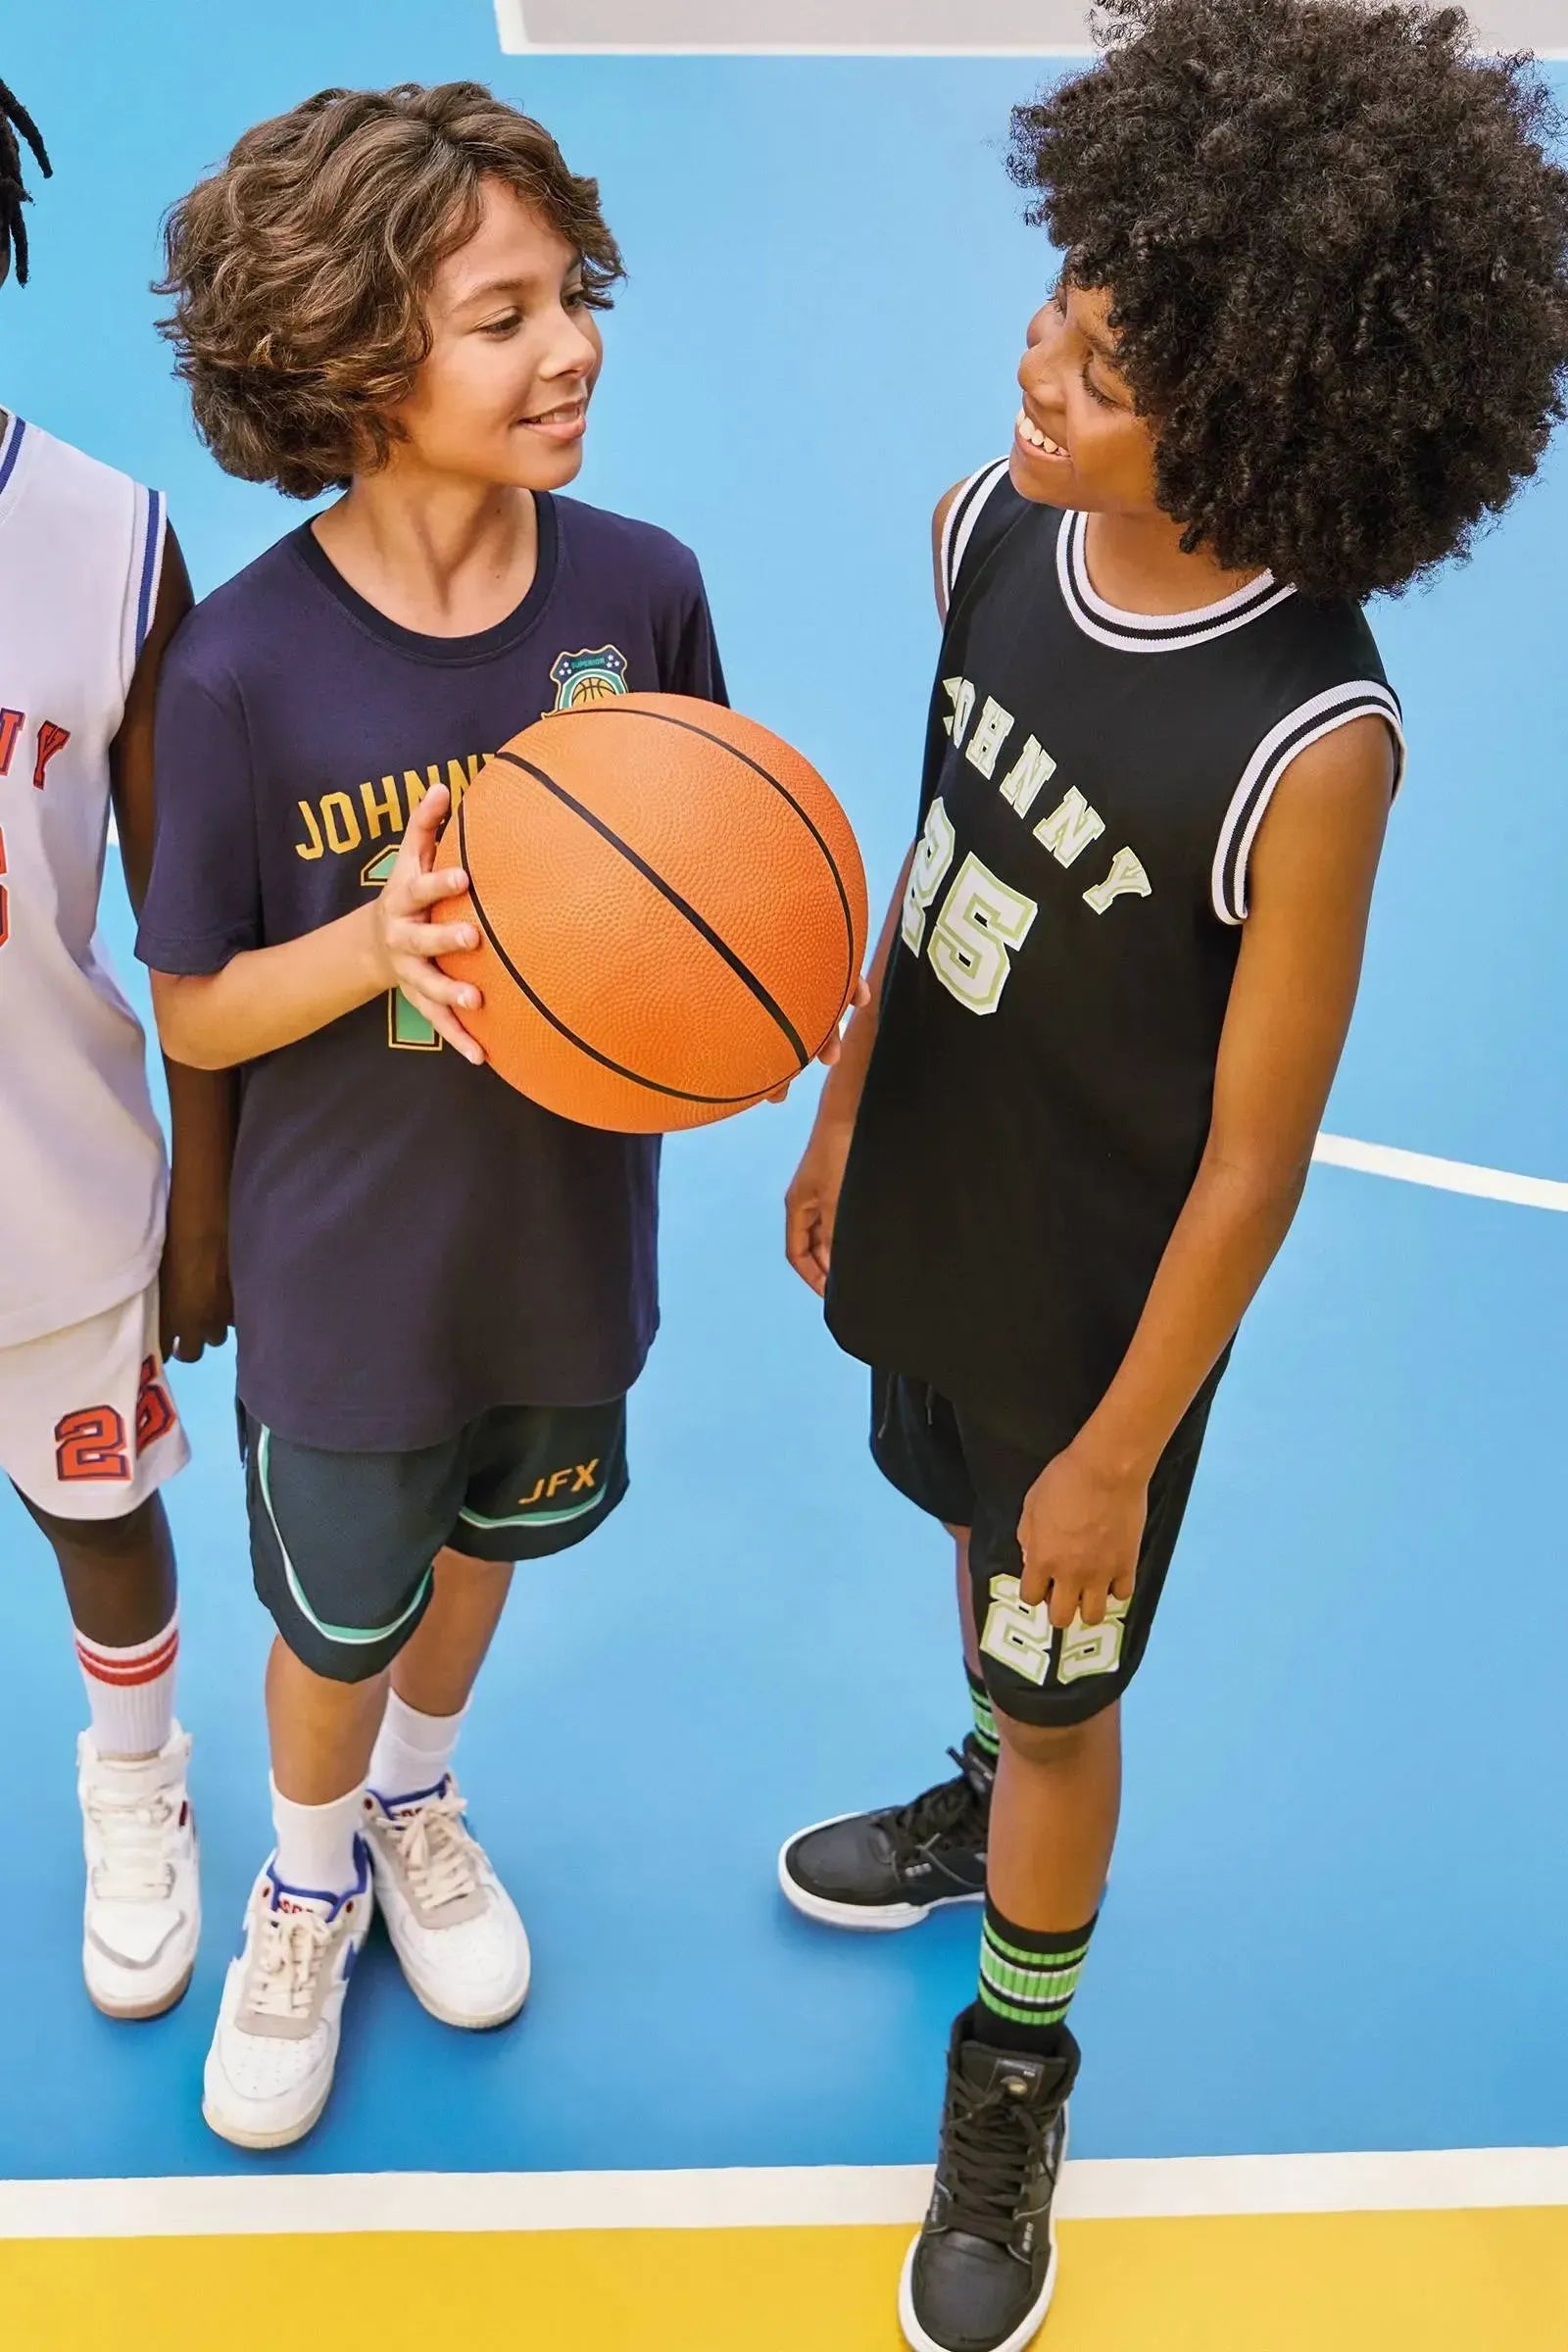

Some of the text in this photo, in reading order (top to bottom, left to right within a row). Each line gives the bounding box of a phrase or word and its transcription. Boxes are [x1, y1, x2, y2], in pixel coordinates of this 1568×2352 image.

[295, 754, 495, 860] JOHNN
[902, 797, 1038, 1015] 25
[517, 1458, 600, 1504] JFX
